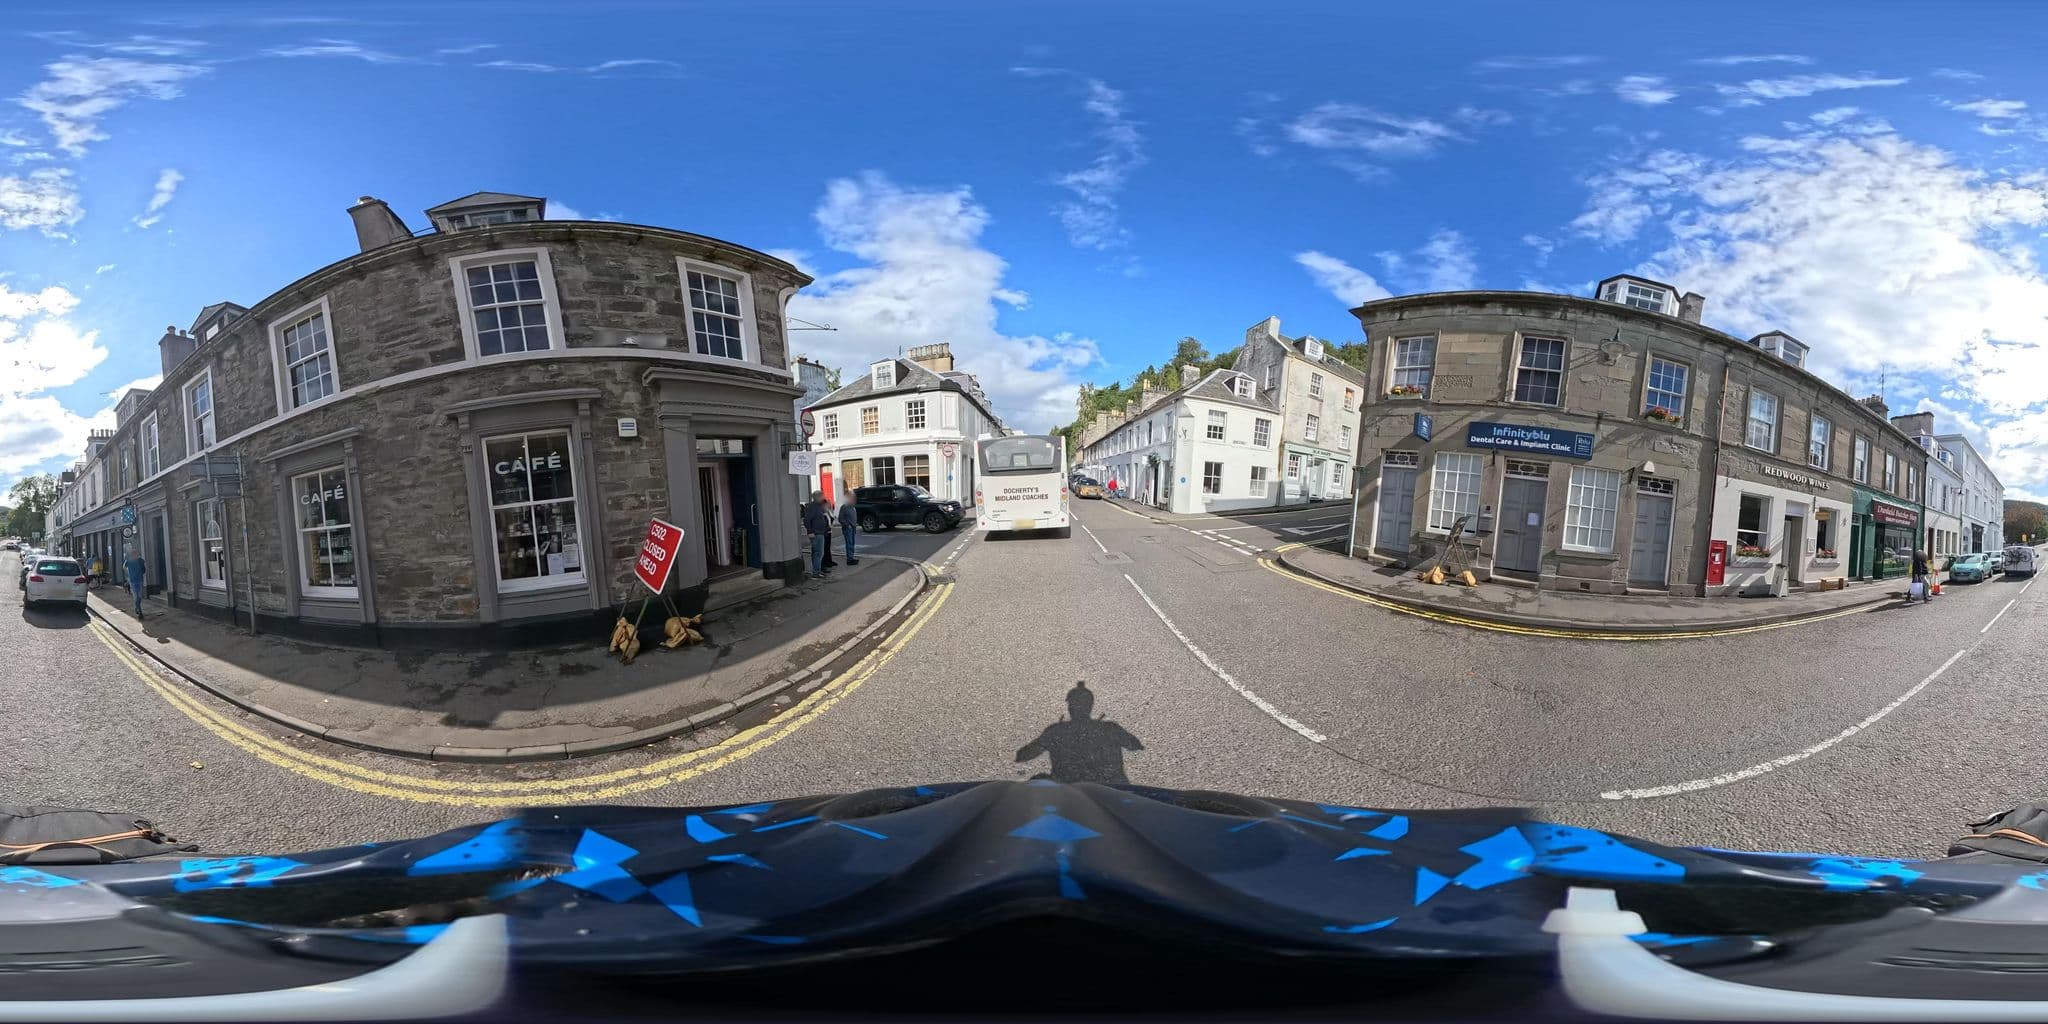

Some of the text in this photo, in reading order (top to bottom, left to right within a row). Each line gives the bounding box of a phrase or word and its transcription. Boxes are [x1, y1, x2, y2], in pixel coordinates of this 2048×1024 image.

[1470, 435, 1494, 444] Dental
[1495, 438, 1512, 446] Care
[1520, 440, 1550, 449] Implant
[1551, 443, 1571, 452] Clinic
[1493, 427, 1550, 440] Infinityblu
[495, 451, 562, 475] CAFÉ
[1765, 466, 1830, 490] REDWOOD WINES
[301, 484, 345, 505] CAFÉ
[995, 493, 1049, 502] MIDLAND COACHES
[643, 539, 666, 561] CLOSED
[639, 554, 657, 575] AHEAD
